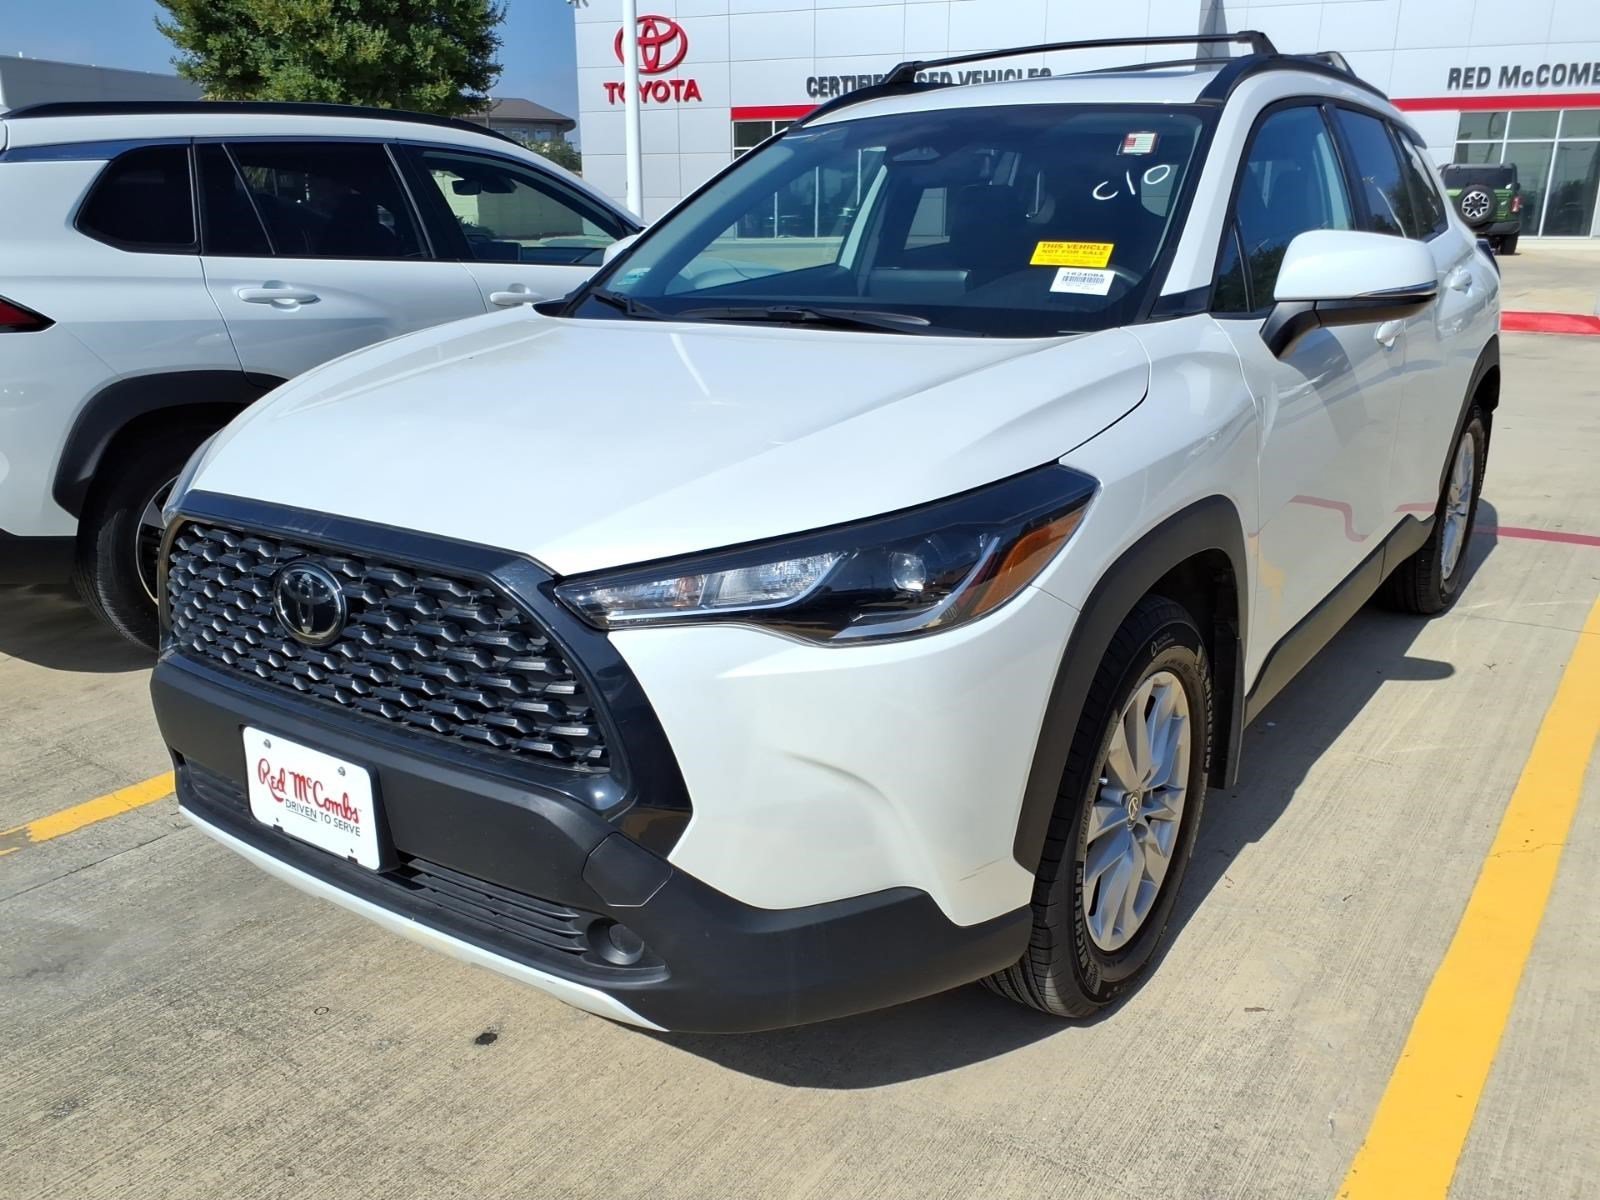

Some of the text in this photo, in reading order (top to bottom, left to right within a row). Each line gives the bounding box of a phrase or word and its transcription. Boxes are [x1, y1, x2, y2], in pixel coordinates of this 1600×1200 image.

[806, 73, 888, 98] CERTIFIE
[1447, 66, 1491, 90] RED
[1066, 243, 1109, 251] VEHICLE
[258, 758, 360, 824] Red McCombs
[285, 798, 361, 837] DRIVEN TO SERVE
[1074, 867, 1088, 969] MICHELIN
